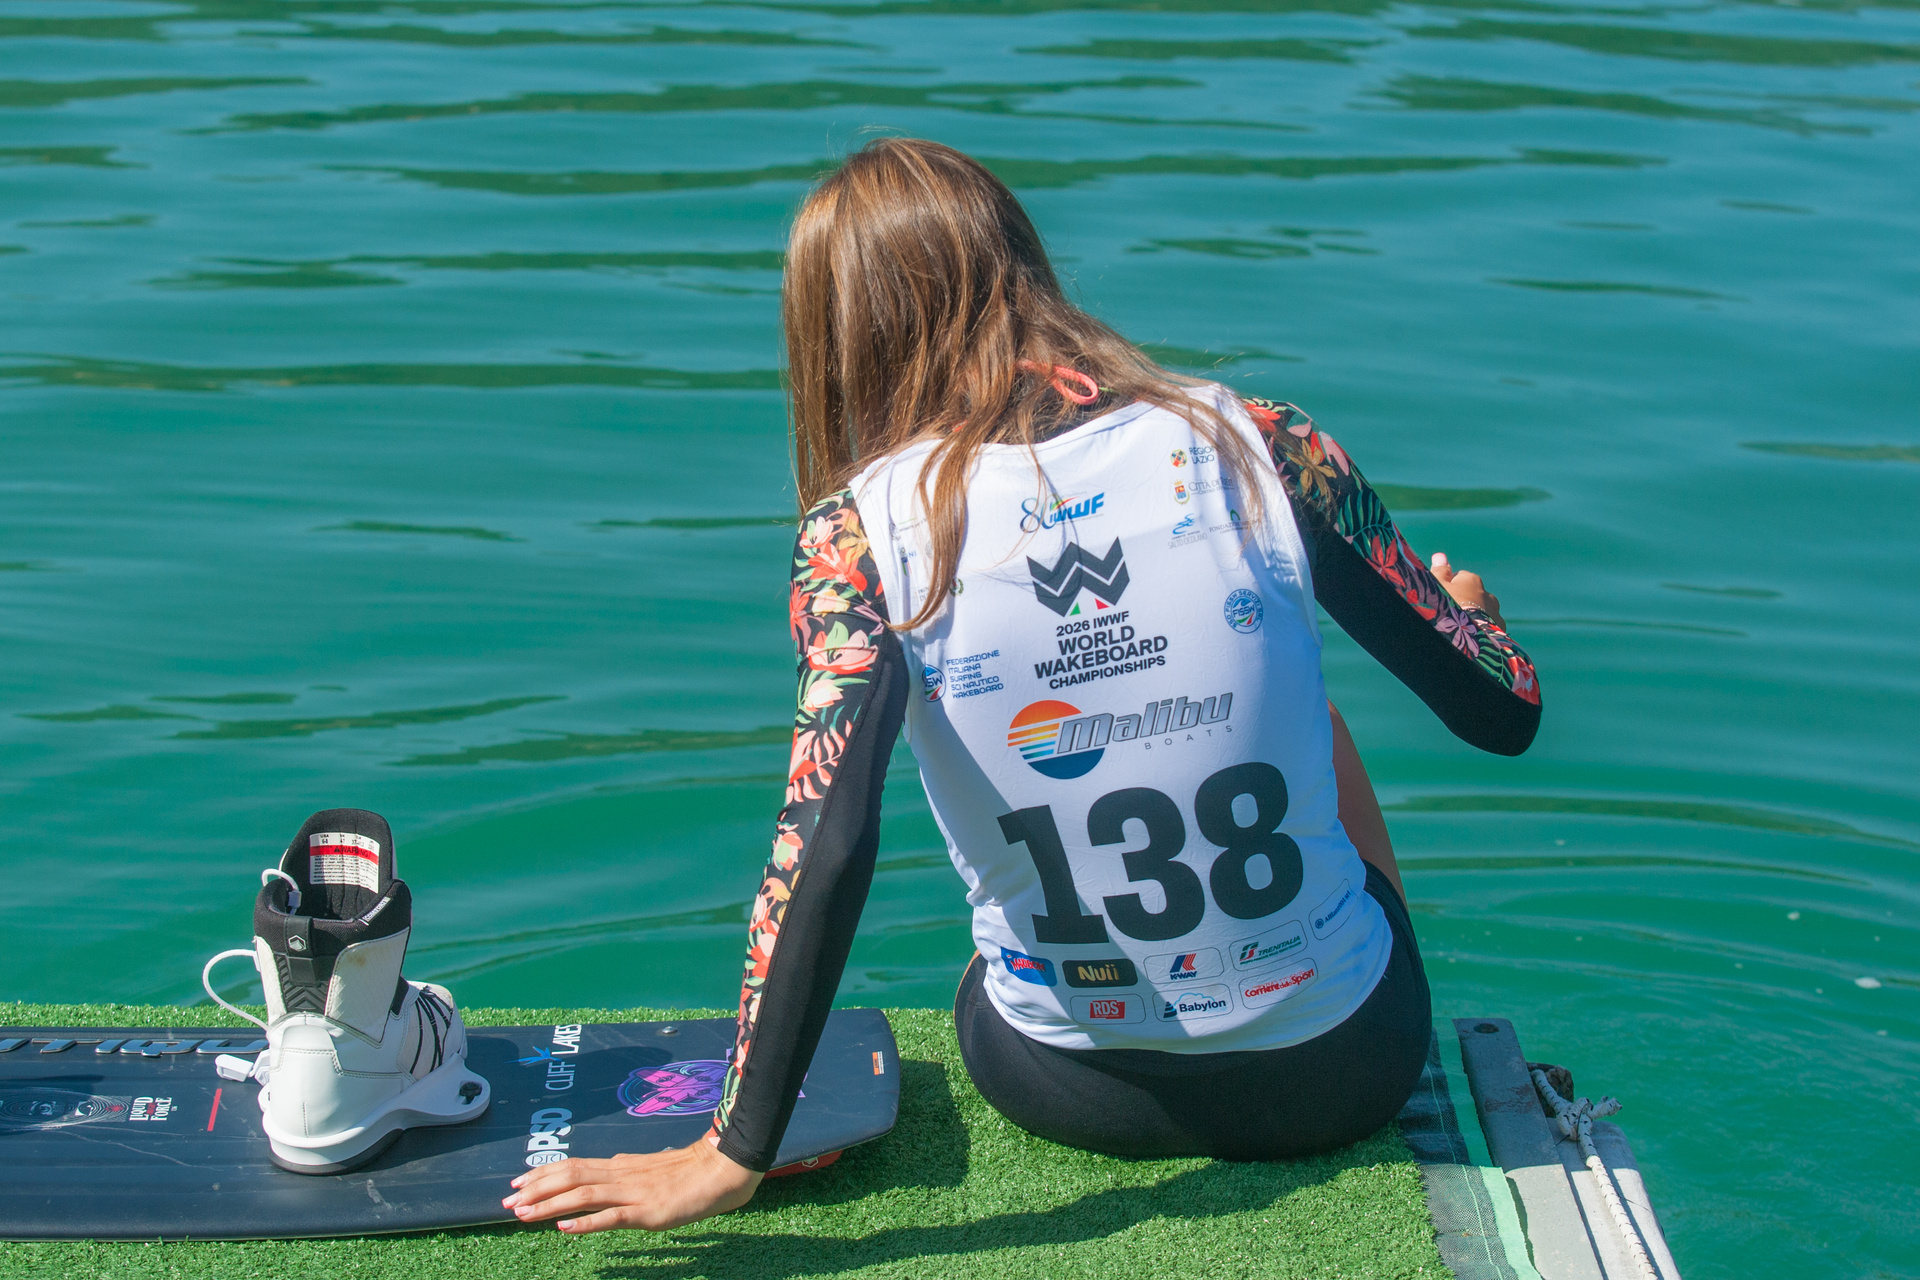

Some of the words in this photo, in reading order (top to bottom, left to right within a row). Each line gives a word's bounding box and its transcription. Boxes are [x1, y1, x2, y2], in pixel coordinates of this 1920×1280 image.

[1189, 446, 1216, 456] REGIO
[1191, 454, 1215, 465] LAZIO
[1232, 604, 1255, 618] FISSW
[1056, 620, 1090, 637] 2026
[1093, 610, 1129, 628] IWWF
[1058, 625, 1135, 656] WORLD
[946, 649, 1000, 666] FEDERAZIONE
[948, 662, 982, 675] ITALIANA
[1034, 635, 1168, 679] WAKEBOARD
[949, 671, 982, 682] SURFING
[951, 683, 961, 691] SCI
[962, 675, 1000, 690] NAUTICO
[1049, 655, 1166, 690] CHAMPIONSHIPS
[952, 683, 1004, 699] WAKEBOARD
[1144, 725, 1233, 750] BOATS
[996, 762, 1304, 945] 138
[1258, 936, 1302, 957] TRENITALIA
[1092, 1001, 1120, 1016] RDS
[1179, 1000, 1227, 1014] Babylon
[551, 1024, 583, 1055] LAKES
[545, 1061, 577, 1091] CLIFF
[129, 1096, 154, 1121] LIQUID
[150, 1096, 173, 1121] FORCE
[527, 1107, 574, 1151] PSD
